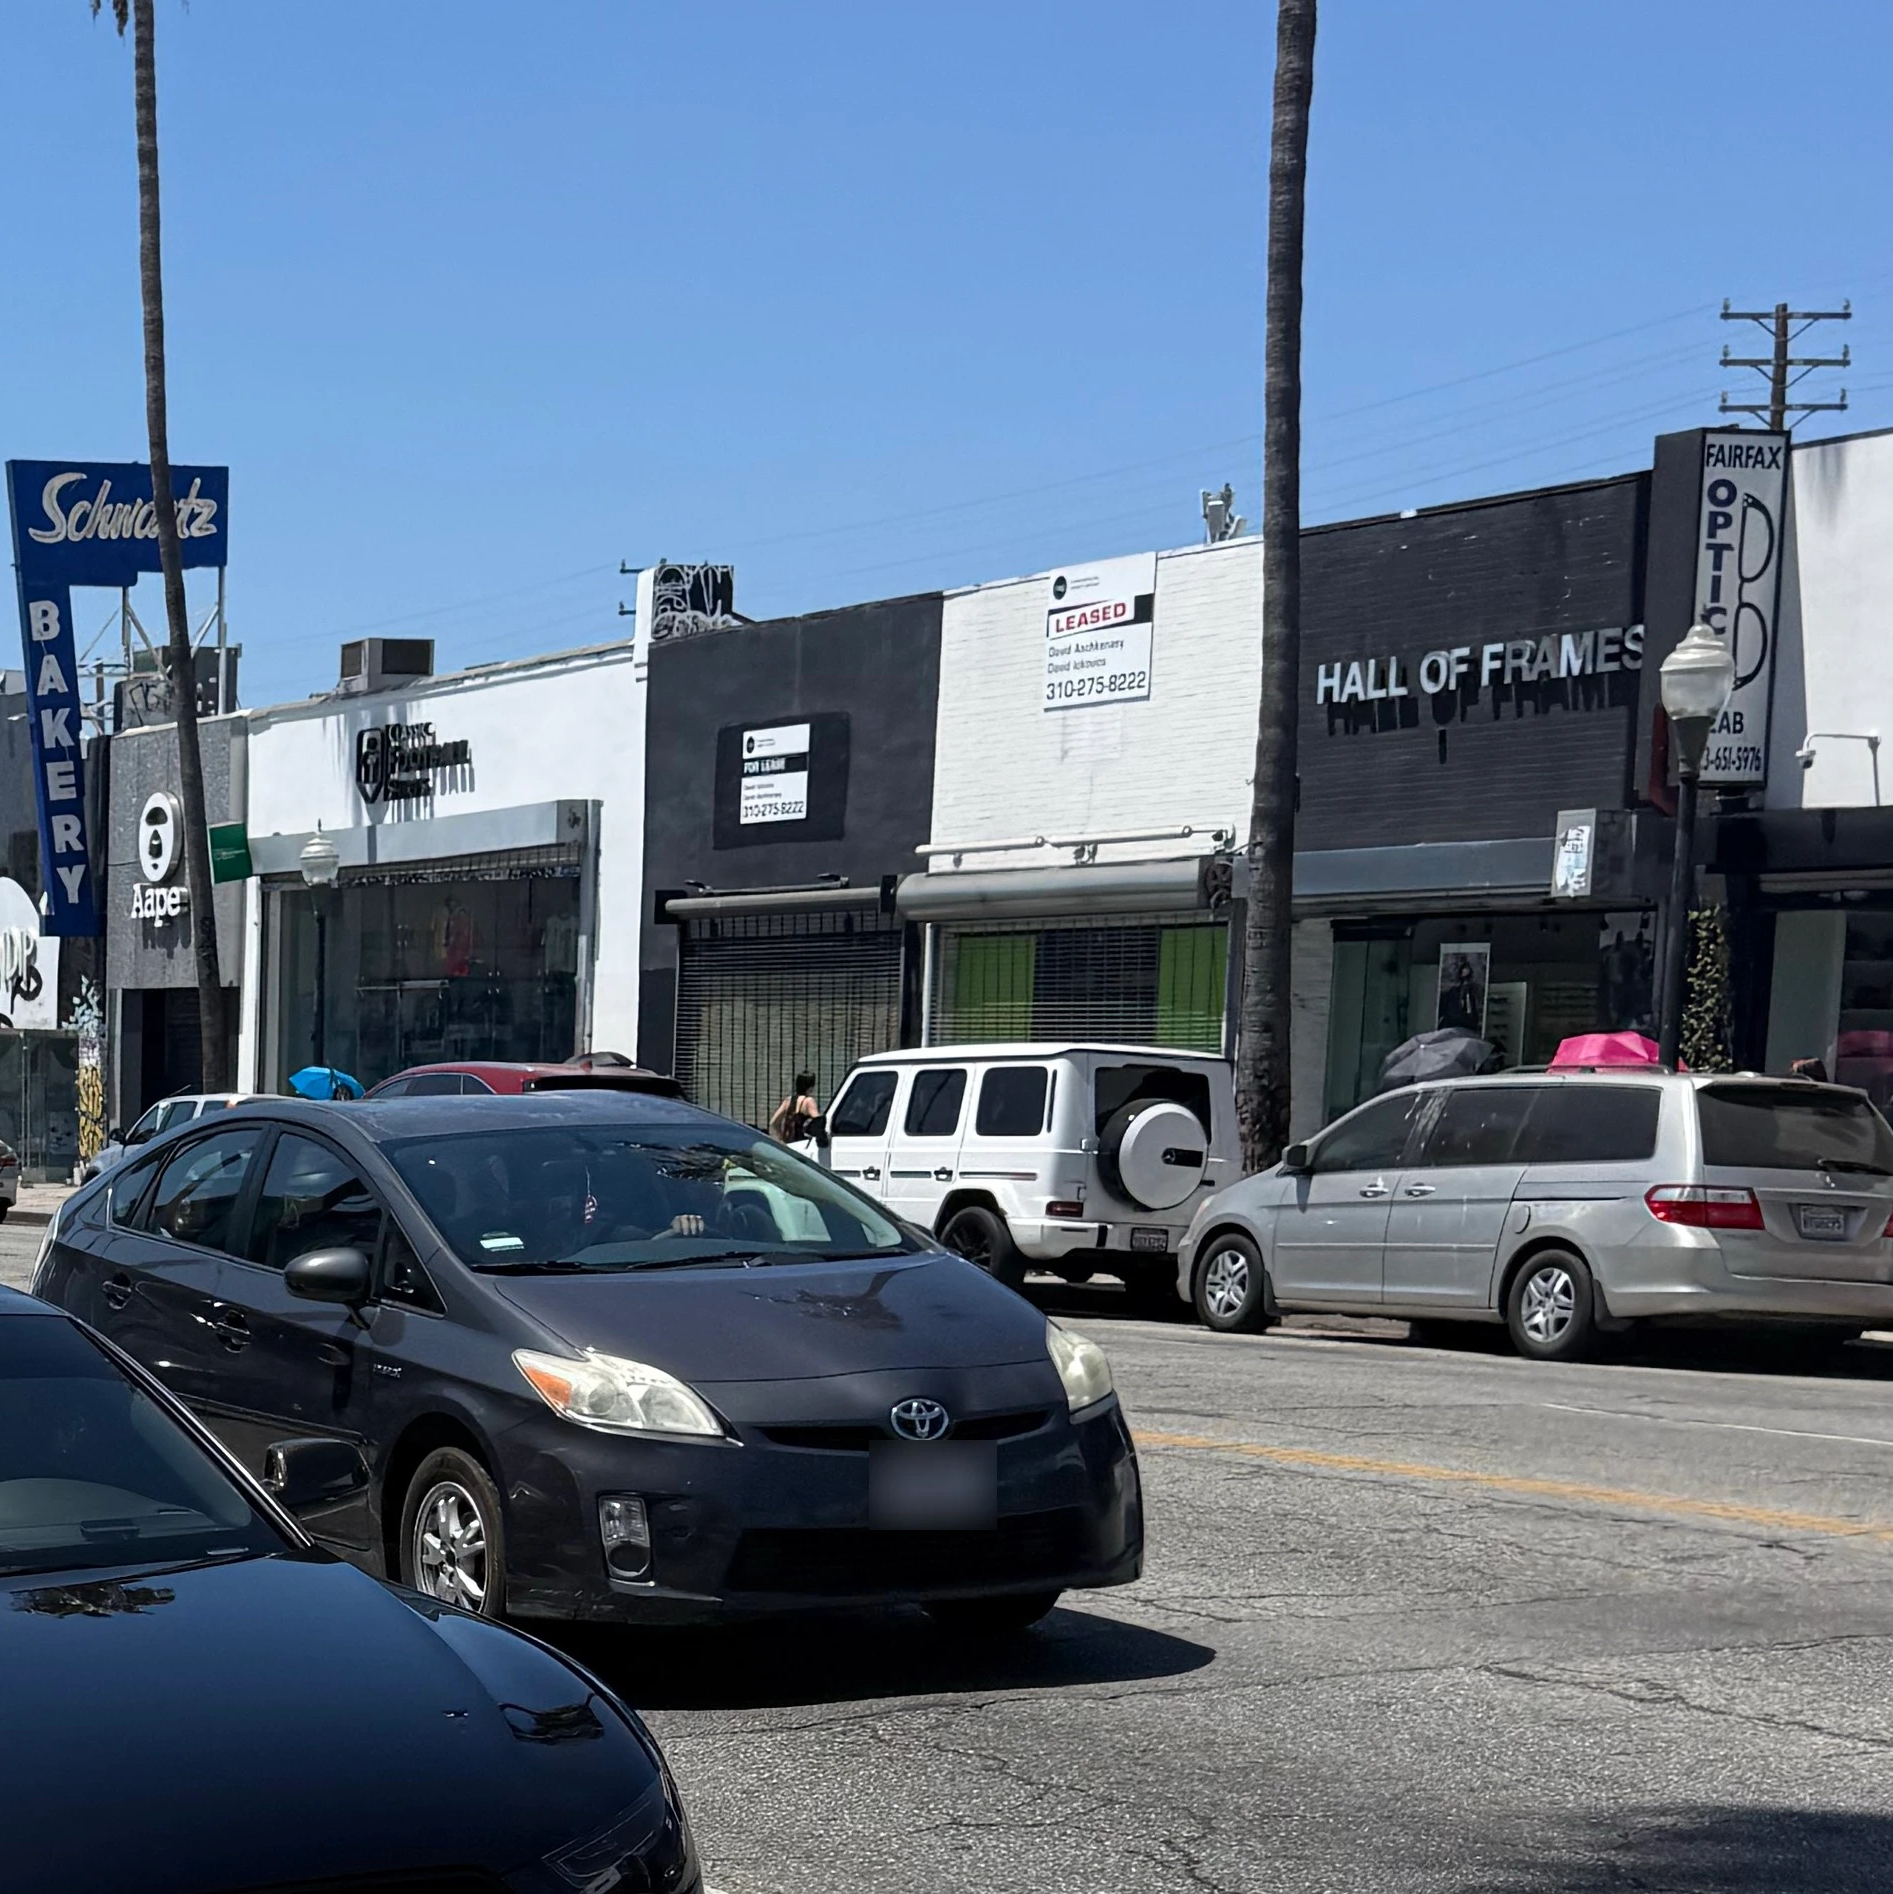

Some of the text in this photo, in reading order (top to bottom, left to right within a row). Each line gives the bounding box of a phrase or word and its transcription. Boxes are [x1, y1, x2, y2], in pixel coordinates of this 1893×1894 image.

[1706, 443, 1781, 470] FAIRFAX
[28, 472, 218, 543] Schwatz
[1056, 603, 1126, 633] LEASED
[1046, 671, 1146, 700] 310-275-8222
[1317, 624, 1644, 704] HALL OF FRAMES
[29, 600, 88, 905] BAKERY
[131, 883, 181, 928] Aape
